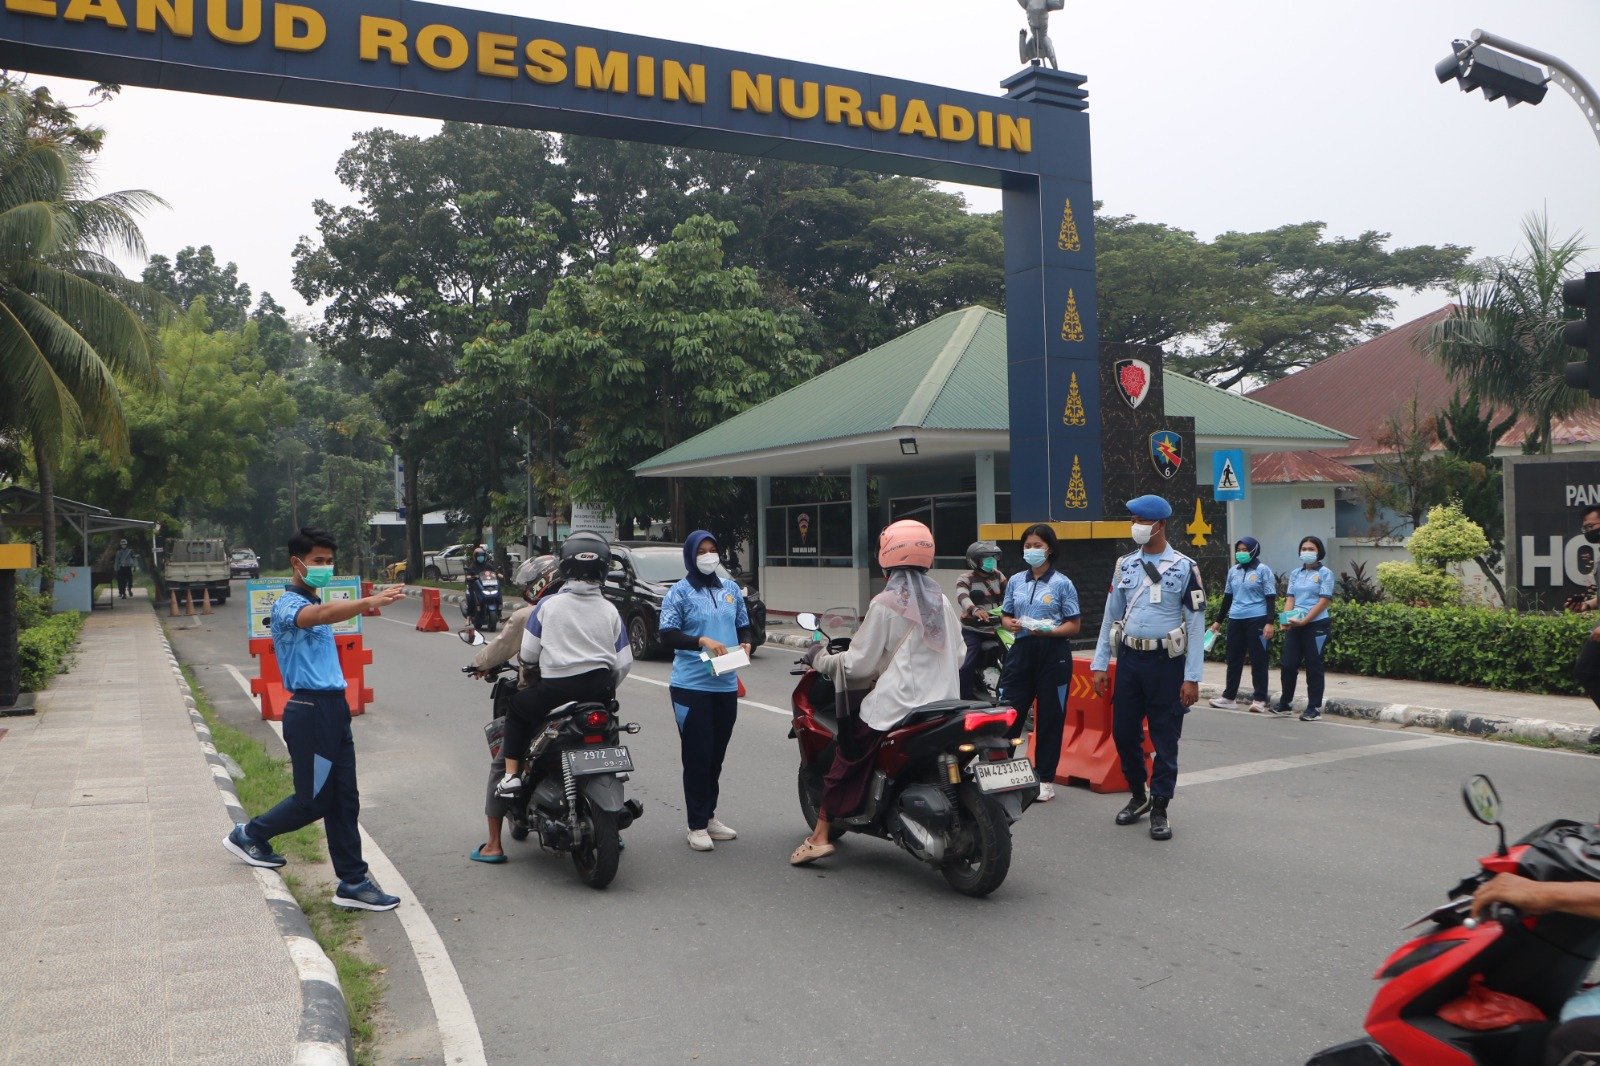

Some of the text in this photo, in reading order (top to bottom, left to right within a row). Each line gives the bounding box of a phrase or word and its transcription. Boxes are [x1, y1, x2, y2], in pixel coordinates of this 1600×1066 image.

[359, 15, 706, 103] ROESMIN
[731, 70, 1032, 153] NURJADIN
[1164, 467, 1171, 477] 6
[570, 753, 577, 762] F
[583, 750, 607, 760] 2972
[978, 761, 1029, 778] BM 4233 ACF
